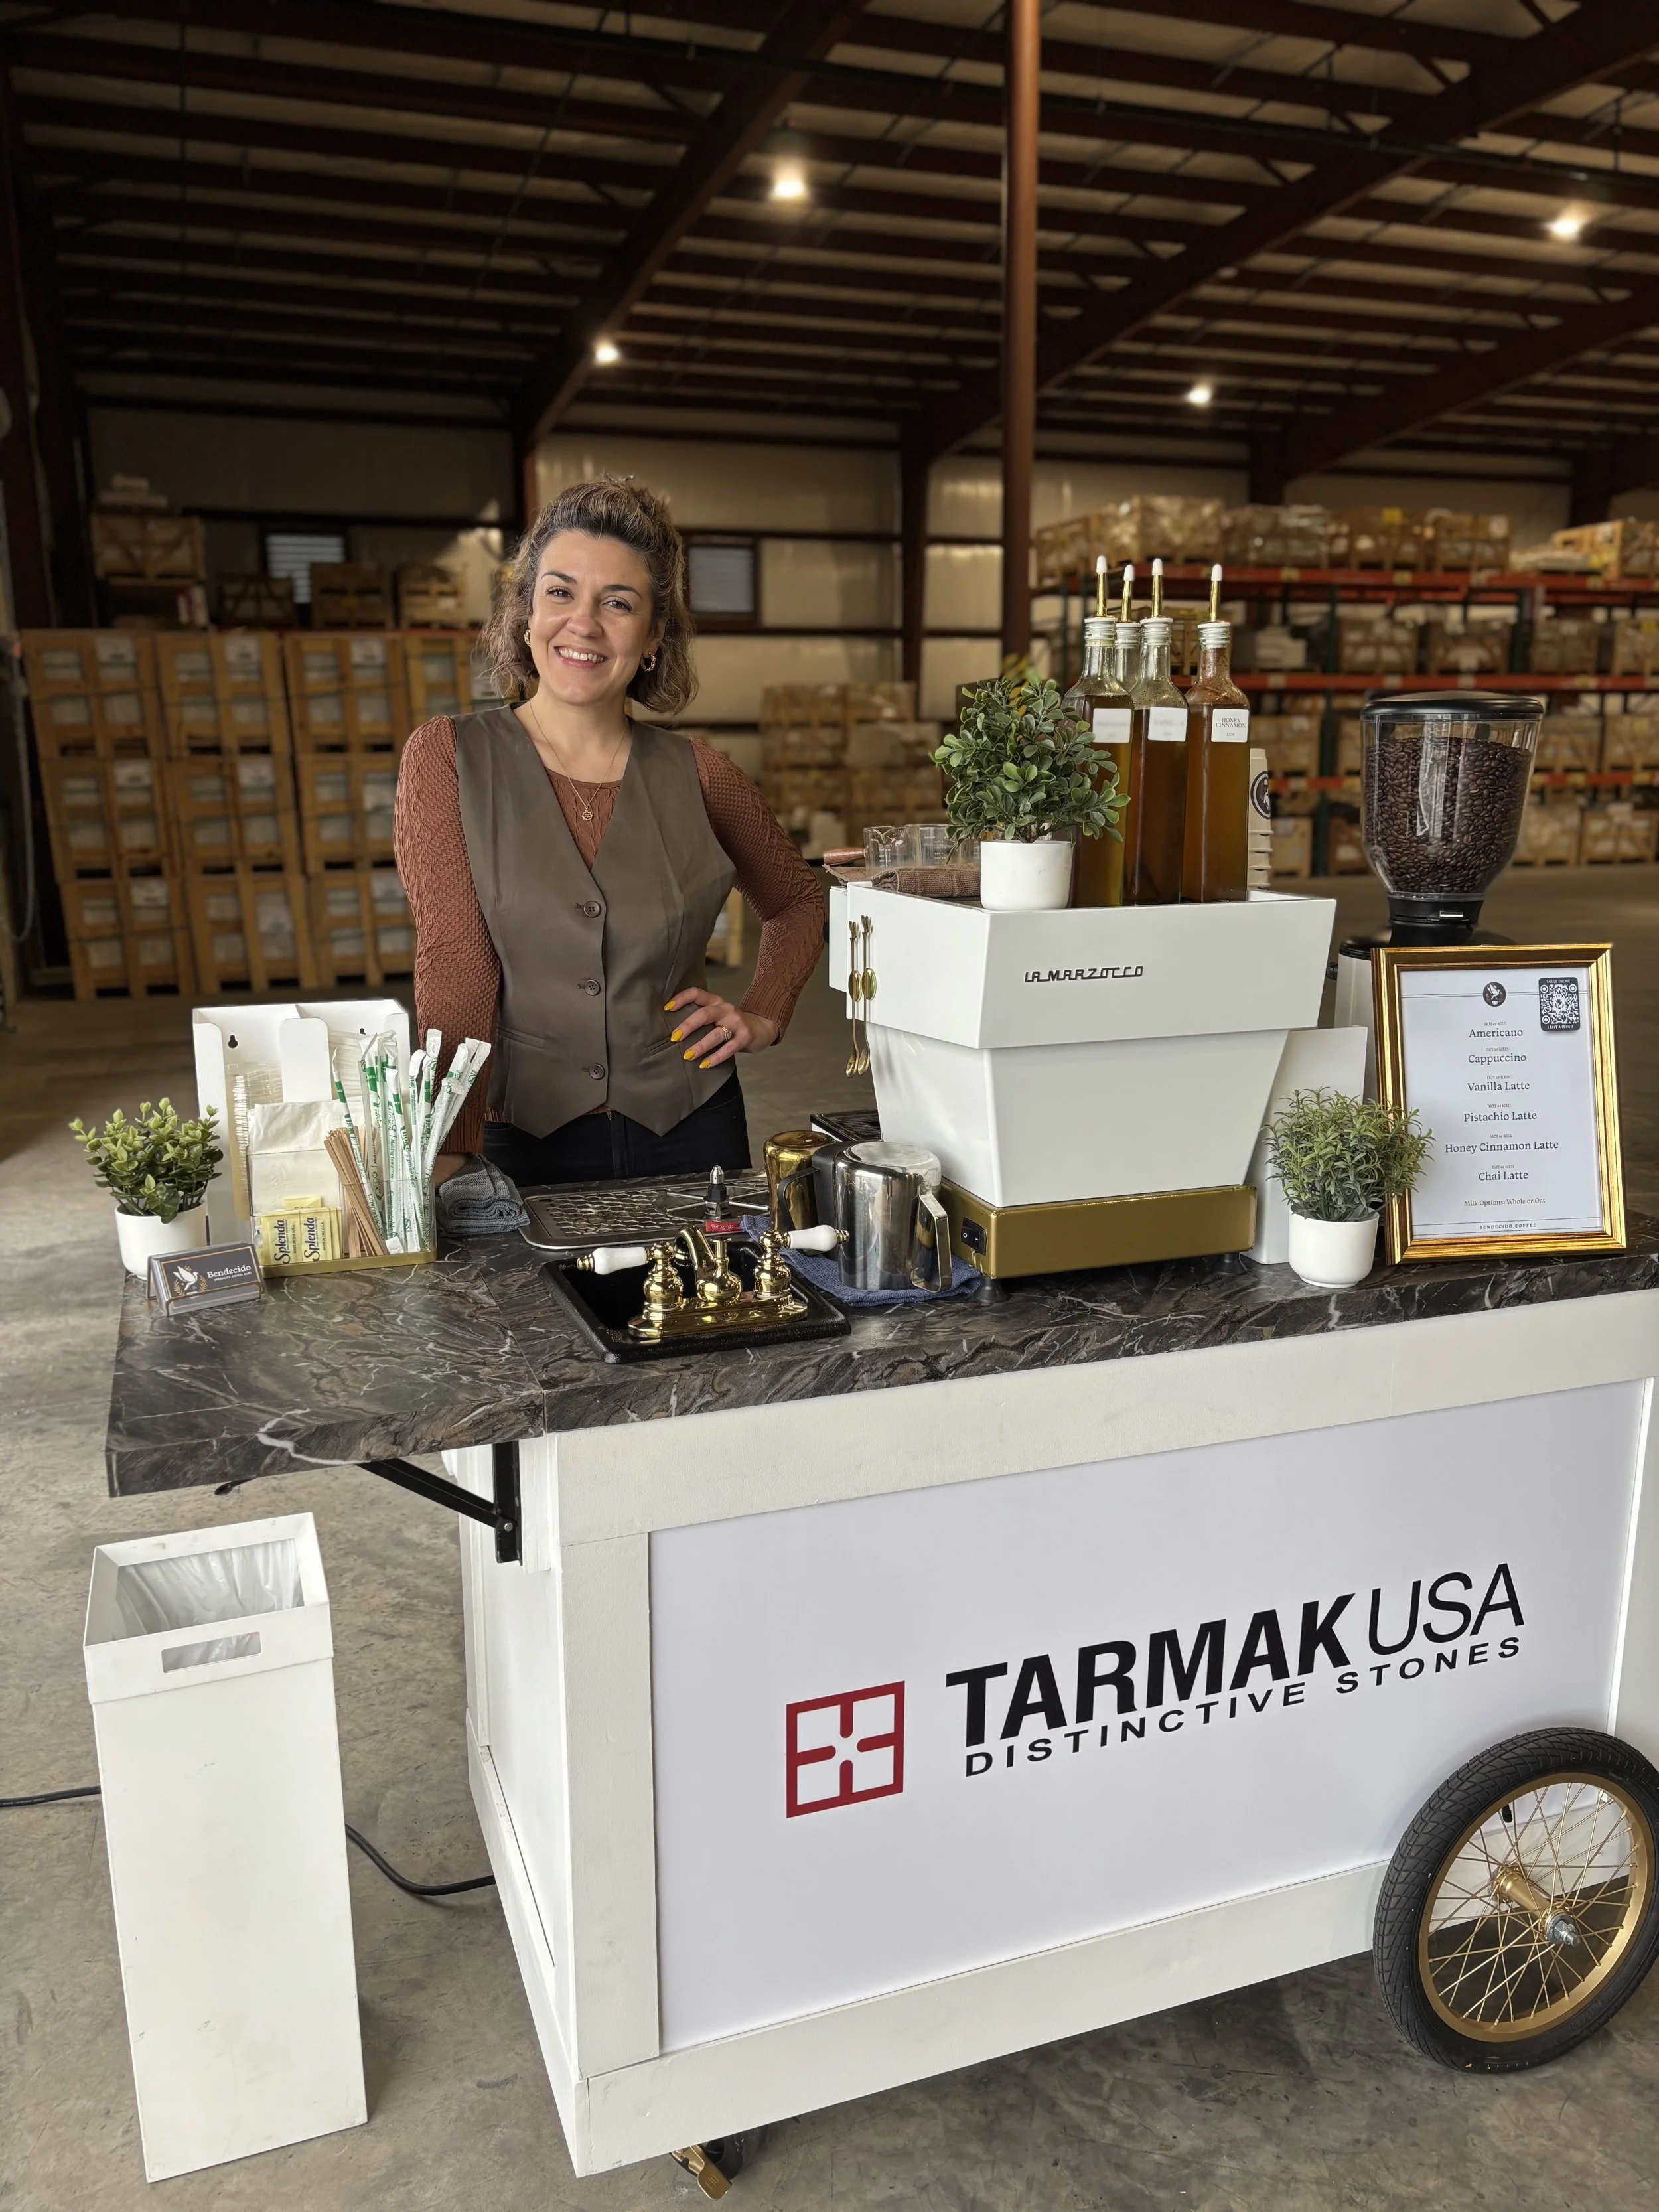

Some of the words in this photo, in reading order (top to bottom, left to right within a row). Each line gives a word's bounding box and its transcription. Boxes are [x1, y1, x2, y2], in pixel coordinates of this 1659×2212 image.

[1469, 1028, 1523, 1038] Americano
[1468, 1053, 1526, 1065] Cappuccino
[1467, 1082, 1502, 1092] Vanilla
[1505, 1082, 1530, 1090] Latte
[1464, 1112, 1510, 1122] Pistachio
[1512, 1111, 1538, 1120] Latte
[1445, 1143, 1477, 1155] Honey
[1479, 1142, 1531, 1151] Cinnamon
[1533, 1141, 1559, 1149] Latte
[1479, 1171, 1500, 1181] Chai
[1503, 1171, 1528, 1180] Latte
[274, 1219, 291, 1265] Splenda
[303, 1216, 320, 1262] Splenda
[207, 1264, 252, 1278] Bendecido
[946, 1593, 1356, 1747] TARMAK
[1368, 1563, 1525, 1655] USA
[966, 1682, 1305, 1777] DISTINCTIVE
[1336, 1637, 1519, 1694] STONES
